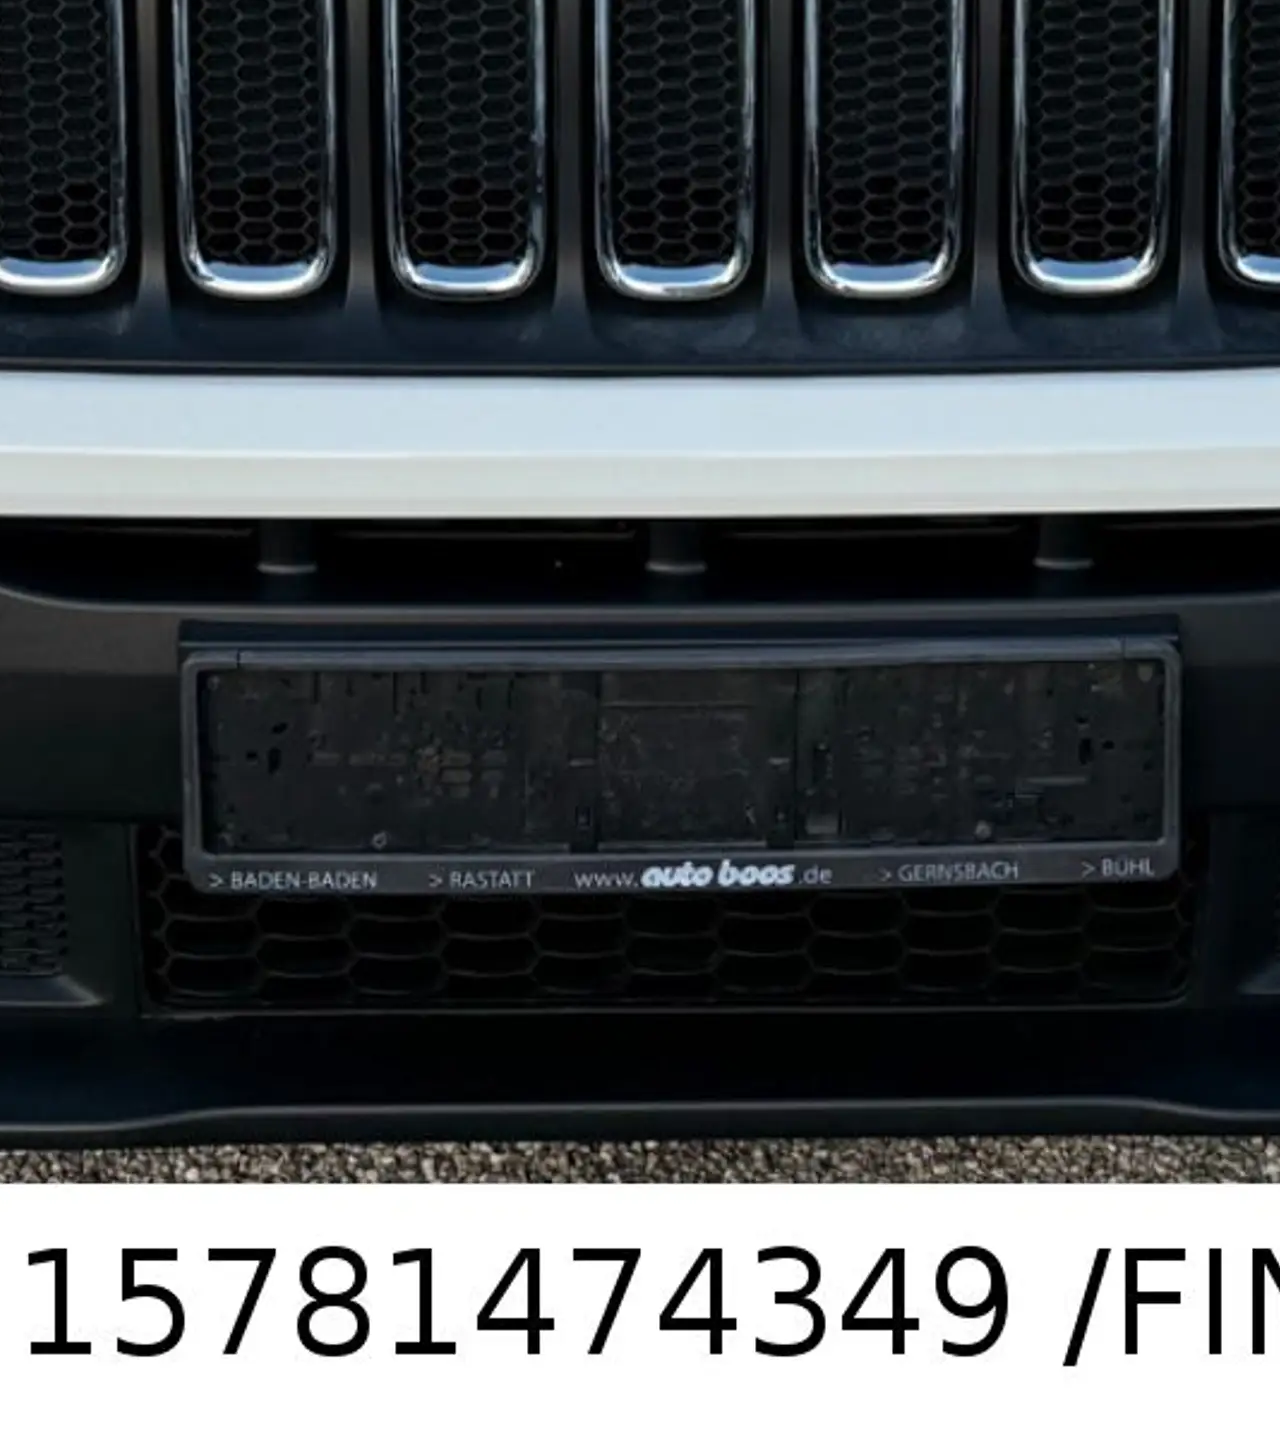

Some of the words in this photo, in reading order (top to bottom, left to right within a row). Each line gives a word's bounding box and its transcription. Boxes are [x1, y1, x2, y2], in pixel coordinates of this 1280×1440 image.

[230, 871, 378, 890] BADEN-BADEN
[450, 871, 535, 889] RASTATT
[897, 861, 1020, 883] GERNSBACH
